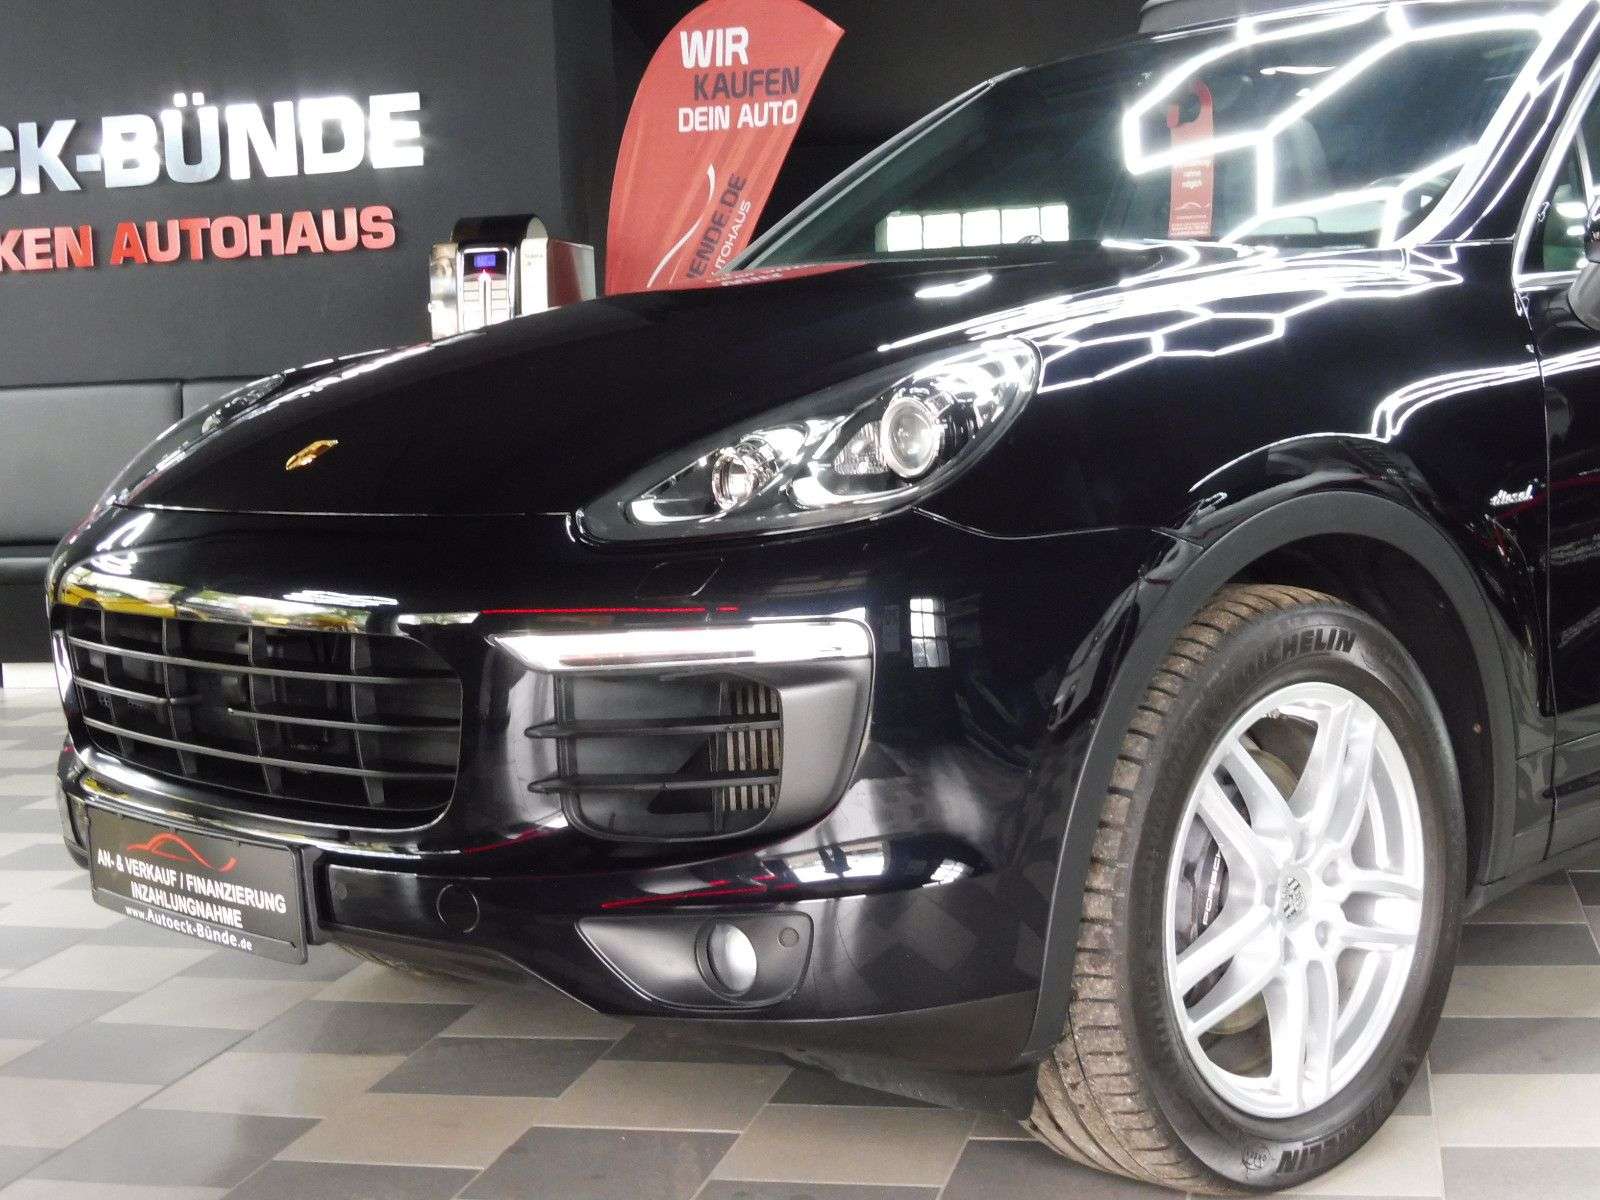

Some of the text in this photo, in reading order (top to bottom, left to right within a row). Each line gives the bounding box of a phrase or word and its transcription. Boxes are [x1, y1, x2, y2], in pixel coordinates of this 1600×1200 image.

[680, 26, 749, 69] WIR
[694, 67, 800, 100] KAUFEN
[678, 99, 798, 132] DEIN AUTO
[110, 205, 396, 265] AUTOHAUS
[97, 847, 115, 868] AN-
[115, 854, 124, 872] &
[124, 857, 177, 887] VERKAUF
[185, 873, 287, 914] FINANZIERUNG
[125, 905, 253, 951] www.Autoeck-Bünde.de
[130, 881, 243, 929] INZAHLUNGNAHME
